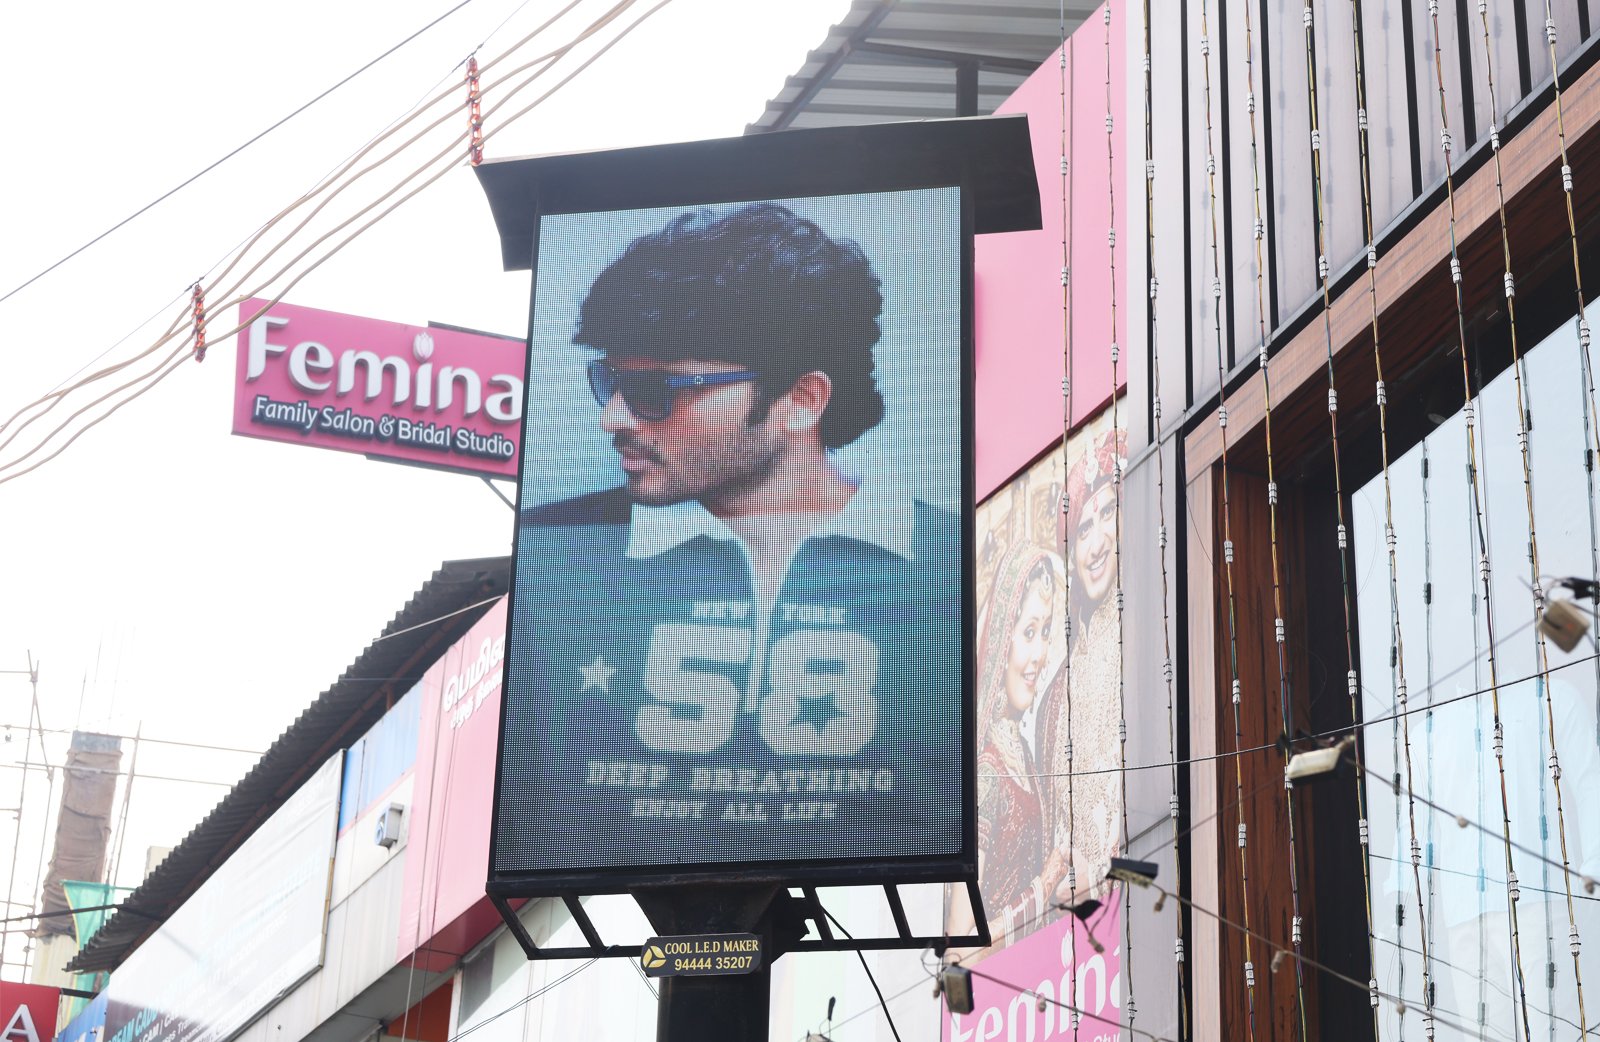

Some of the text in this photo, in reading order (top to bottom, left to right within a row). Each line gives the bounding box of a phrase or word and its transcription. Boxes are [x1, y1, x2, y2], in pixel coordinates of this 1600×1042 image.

[246, 315, 524, 424] Femina
[255, 396, 514, 456] Family Salon & Bridal Studio
[691, 600, 751, 619] NEW
[585, 760, 895, 793] DEEP BREATHING
[632, 798, 838, 821] ENJOY ALL LIFE
[664, 942, 692, 954] COOL
[723, 939, 759, 952] MAKER
[674, 956, 752, 970] 94444 35207
[951, 930, 1119, 1042] emin
